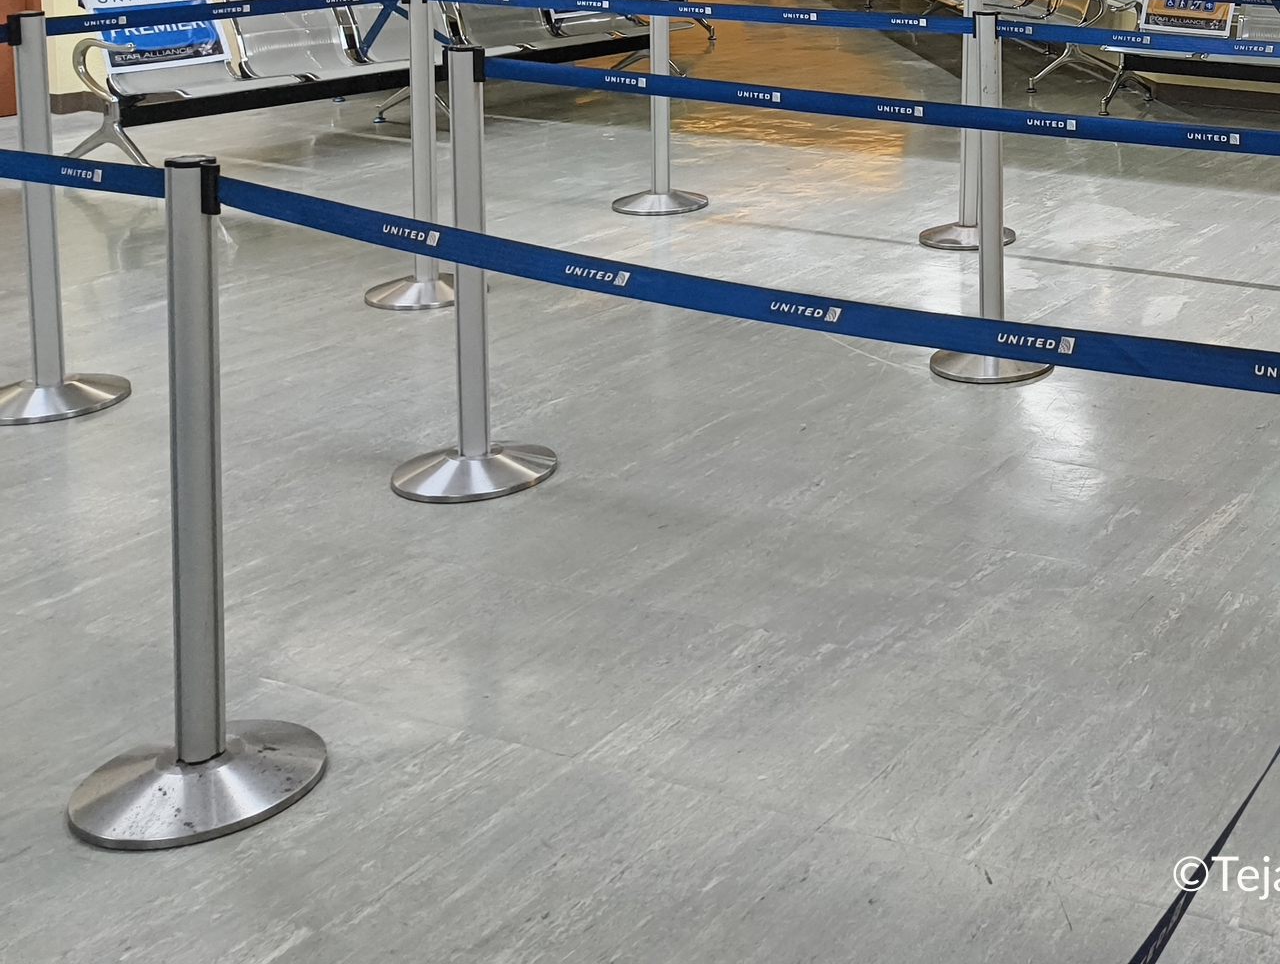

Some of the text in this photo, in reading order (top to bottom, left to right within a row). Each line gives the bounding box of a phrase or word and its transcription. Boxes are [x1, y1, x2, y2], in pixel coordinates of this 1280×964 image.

[213, 7, 242, 15] UNITED
[84, 18, 117, 26] UNITED
[996, 25, 1024, 33] UNITED
[1112, 35, 1142, 43] UNITED
[115, 46, 193, 62] STAR ALLIANCE
[1234, 45, 1263, 53] UNITED
[604, 75, 636, 85] UNITED
[737, 90, 771, 100] UNITED
[877, 105, 912, 114] UNITED
[1027, 118, 1065, 128] UNITED
[1187, 132, 1227, 142] UNITED
[61, 167, 92, 179] UNITED
[382, 224, 425, 241] UNITED
[565, 265, 613, 281] UNITED
[770, 301, 823, 318] UNITED
[997, 332, 1056, 349] UNITED
